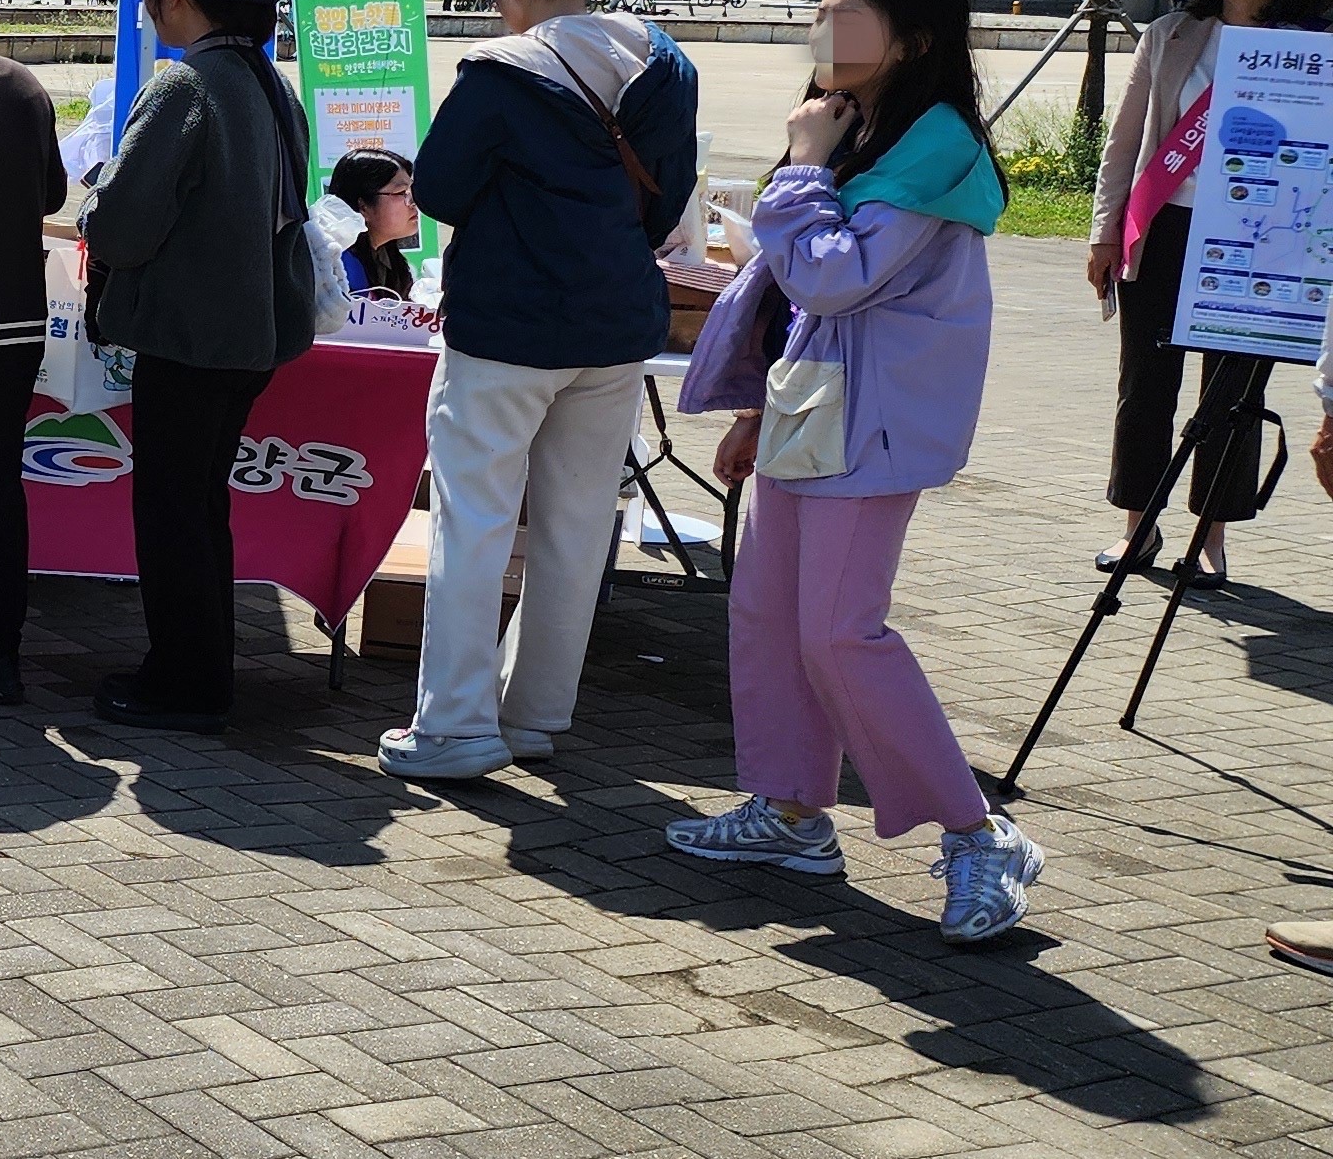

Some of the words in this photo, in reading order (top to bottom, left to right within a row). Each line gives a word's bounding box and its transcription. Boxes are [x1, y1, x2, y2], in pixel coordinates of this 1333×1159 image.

[314, 5, 348, 33] 청양
[326, 103, 349, 115] 화려한
[1164, 150, 1186, 174] 해
[49, 300, 74, 311] 충남의
[401, 305, 446, 334] 청양
[234, 442, 363, 498] 양군
